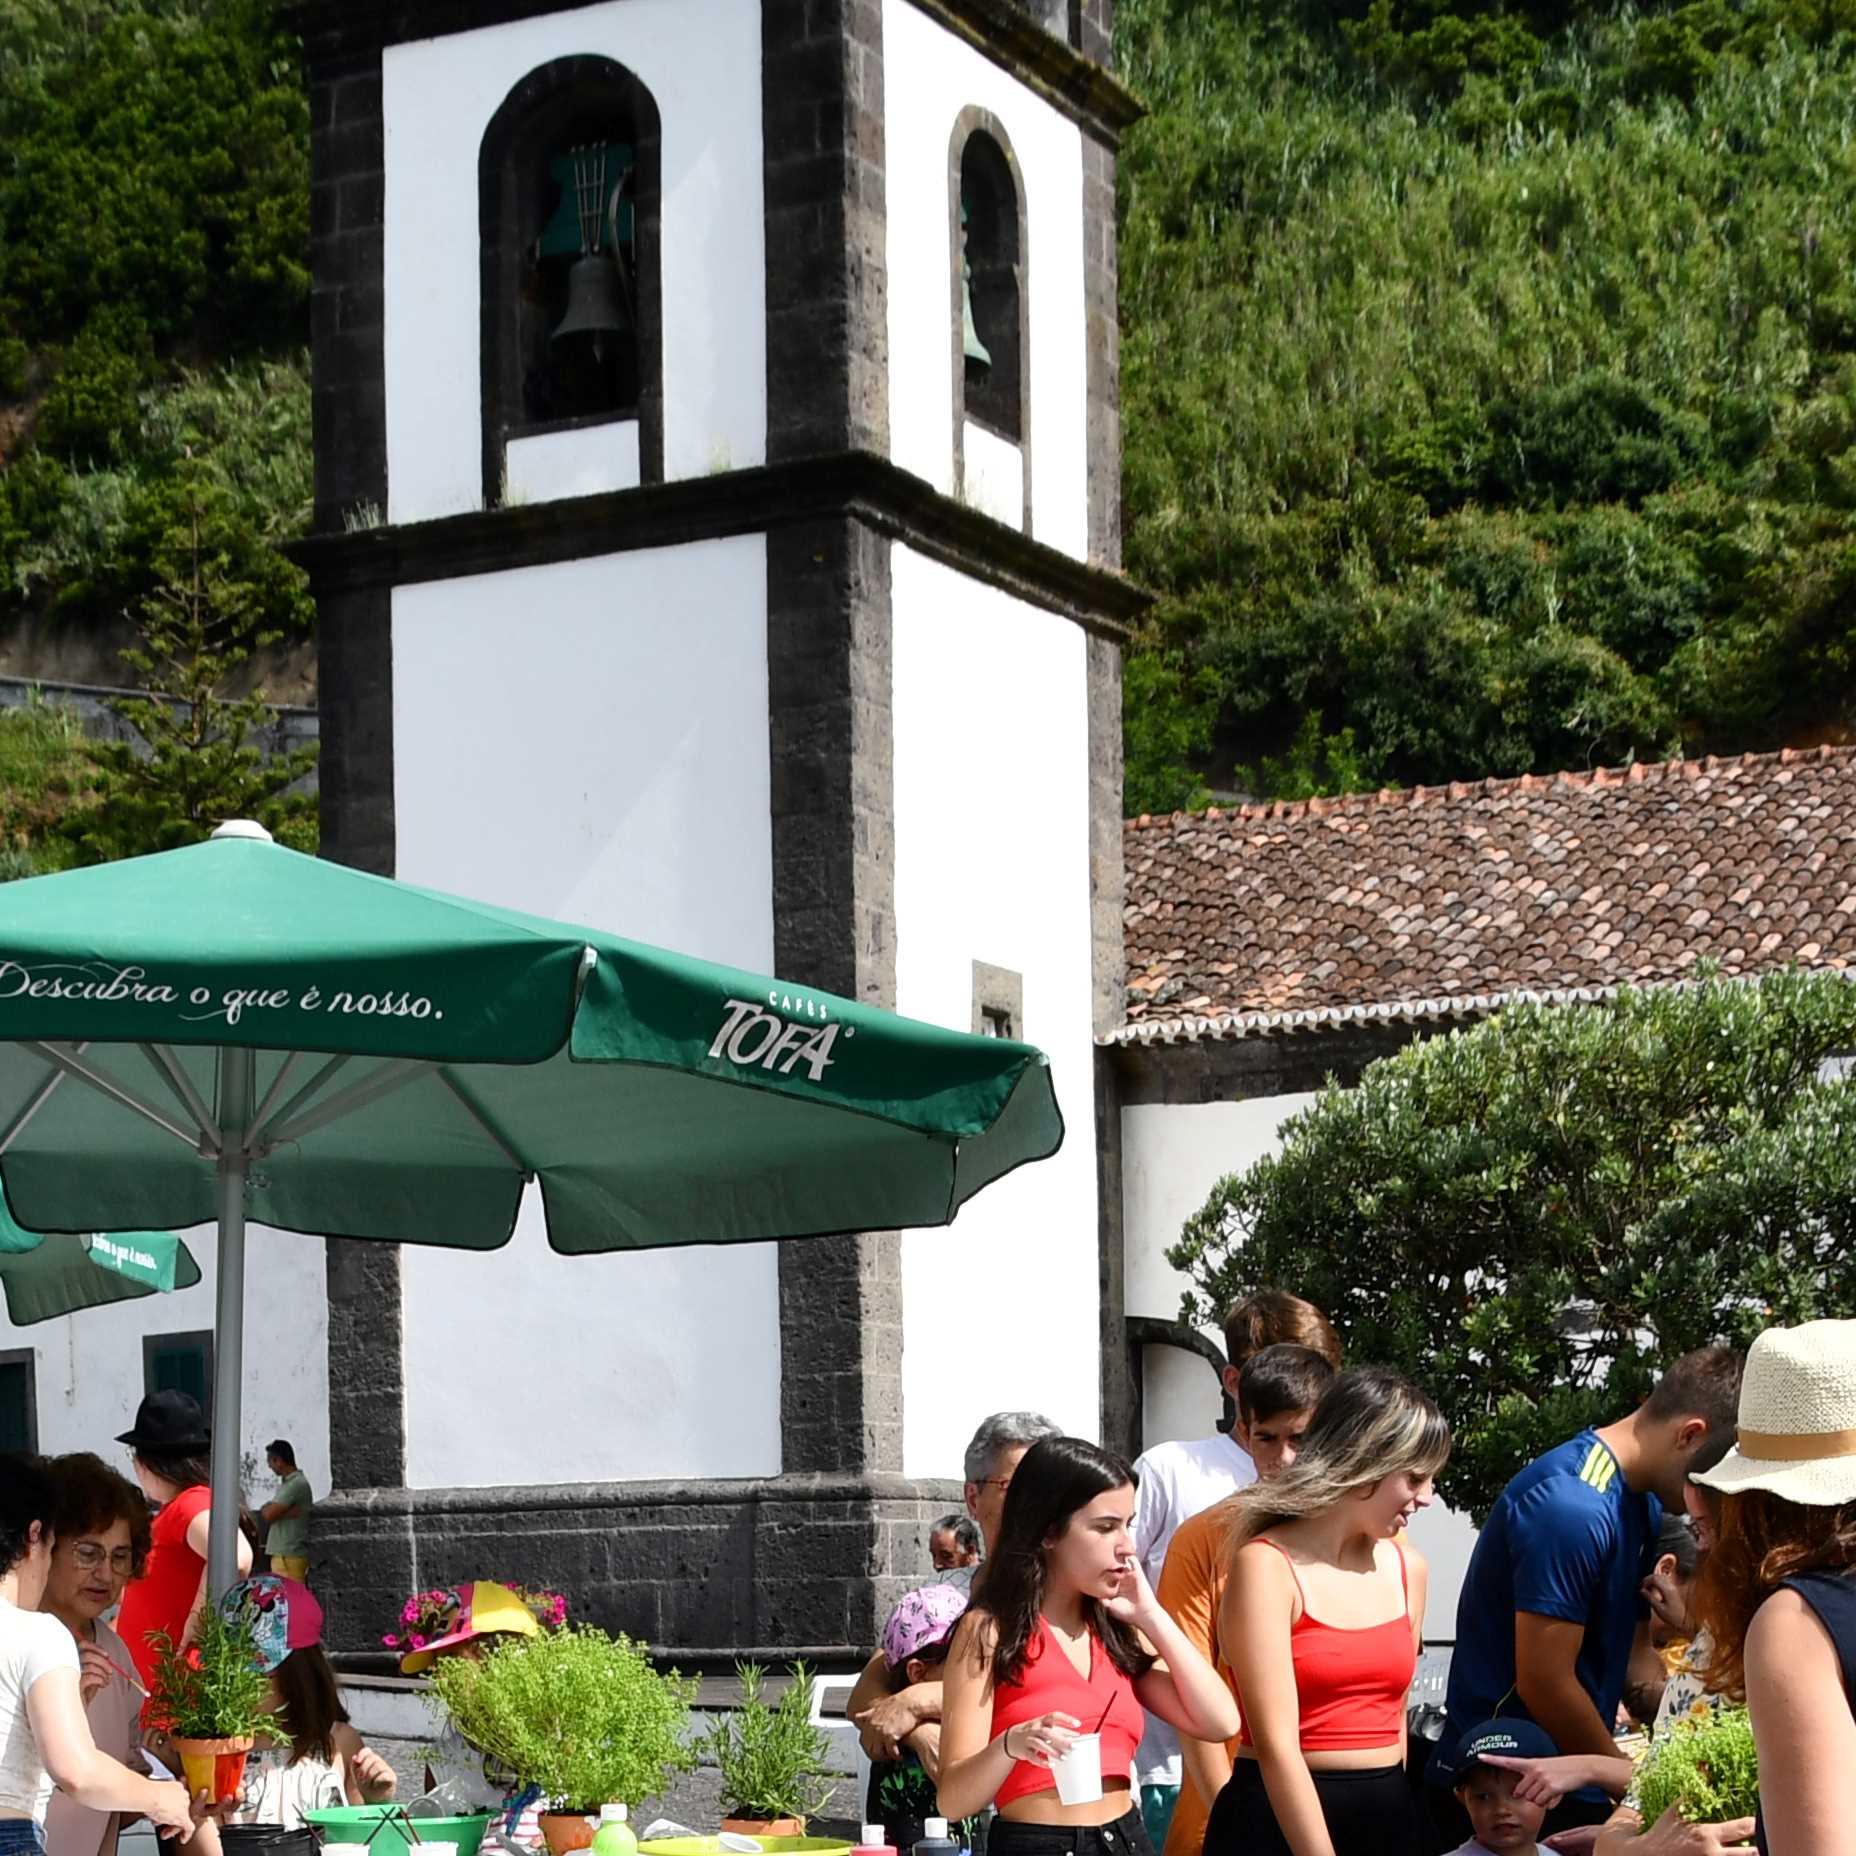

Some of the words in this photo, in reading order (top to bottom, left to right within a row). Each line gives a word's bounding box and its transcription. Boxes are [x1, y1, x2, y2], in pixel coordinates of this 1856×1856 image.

[178, 985, 291, 1025] que
[189, 985, 211, 1005] o
[300, 984, 322, 1011] é
[327, 991, 444, 1020] nosso.
[708, 999, 841, 1081] TOFA
[1466, 1741, 1519, 1758] ARMOUR
[1471, 1734, 1513, 1749] UNDER
